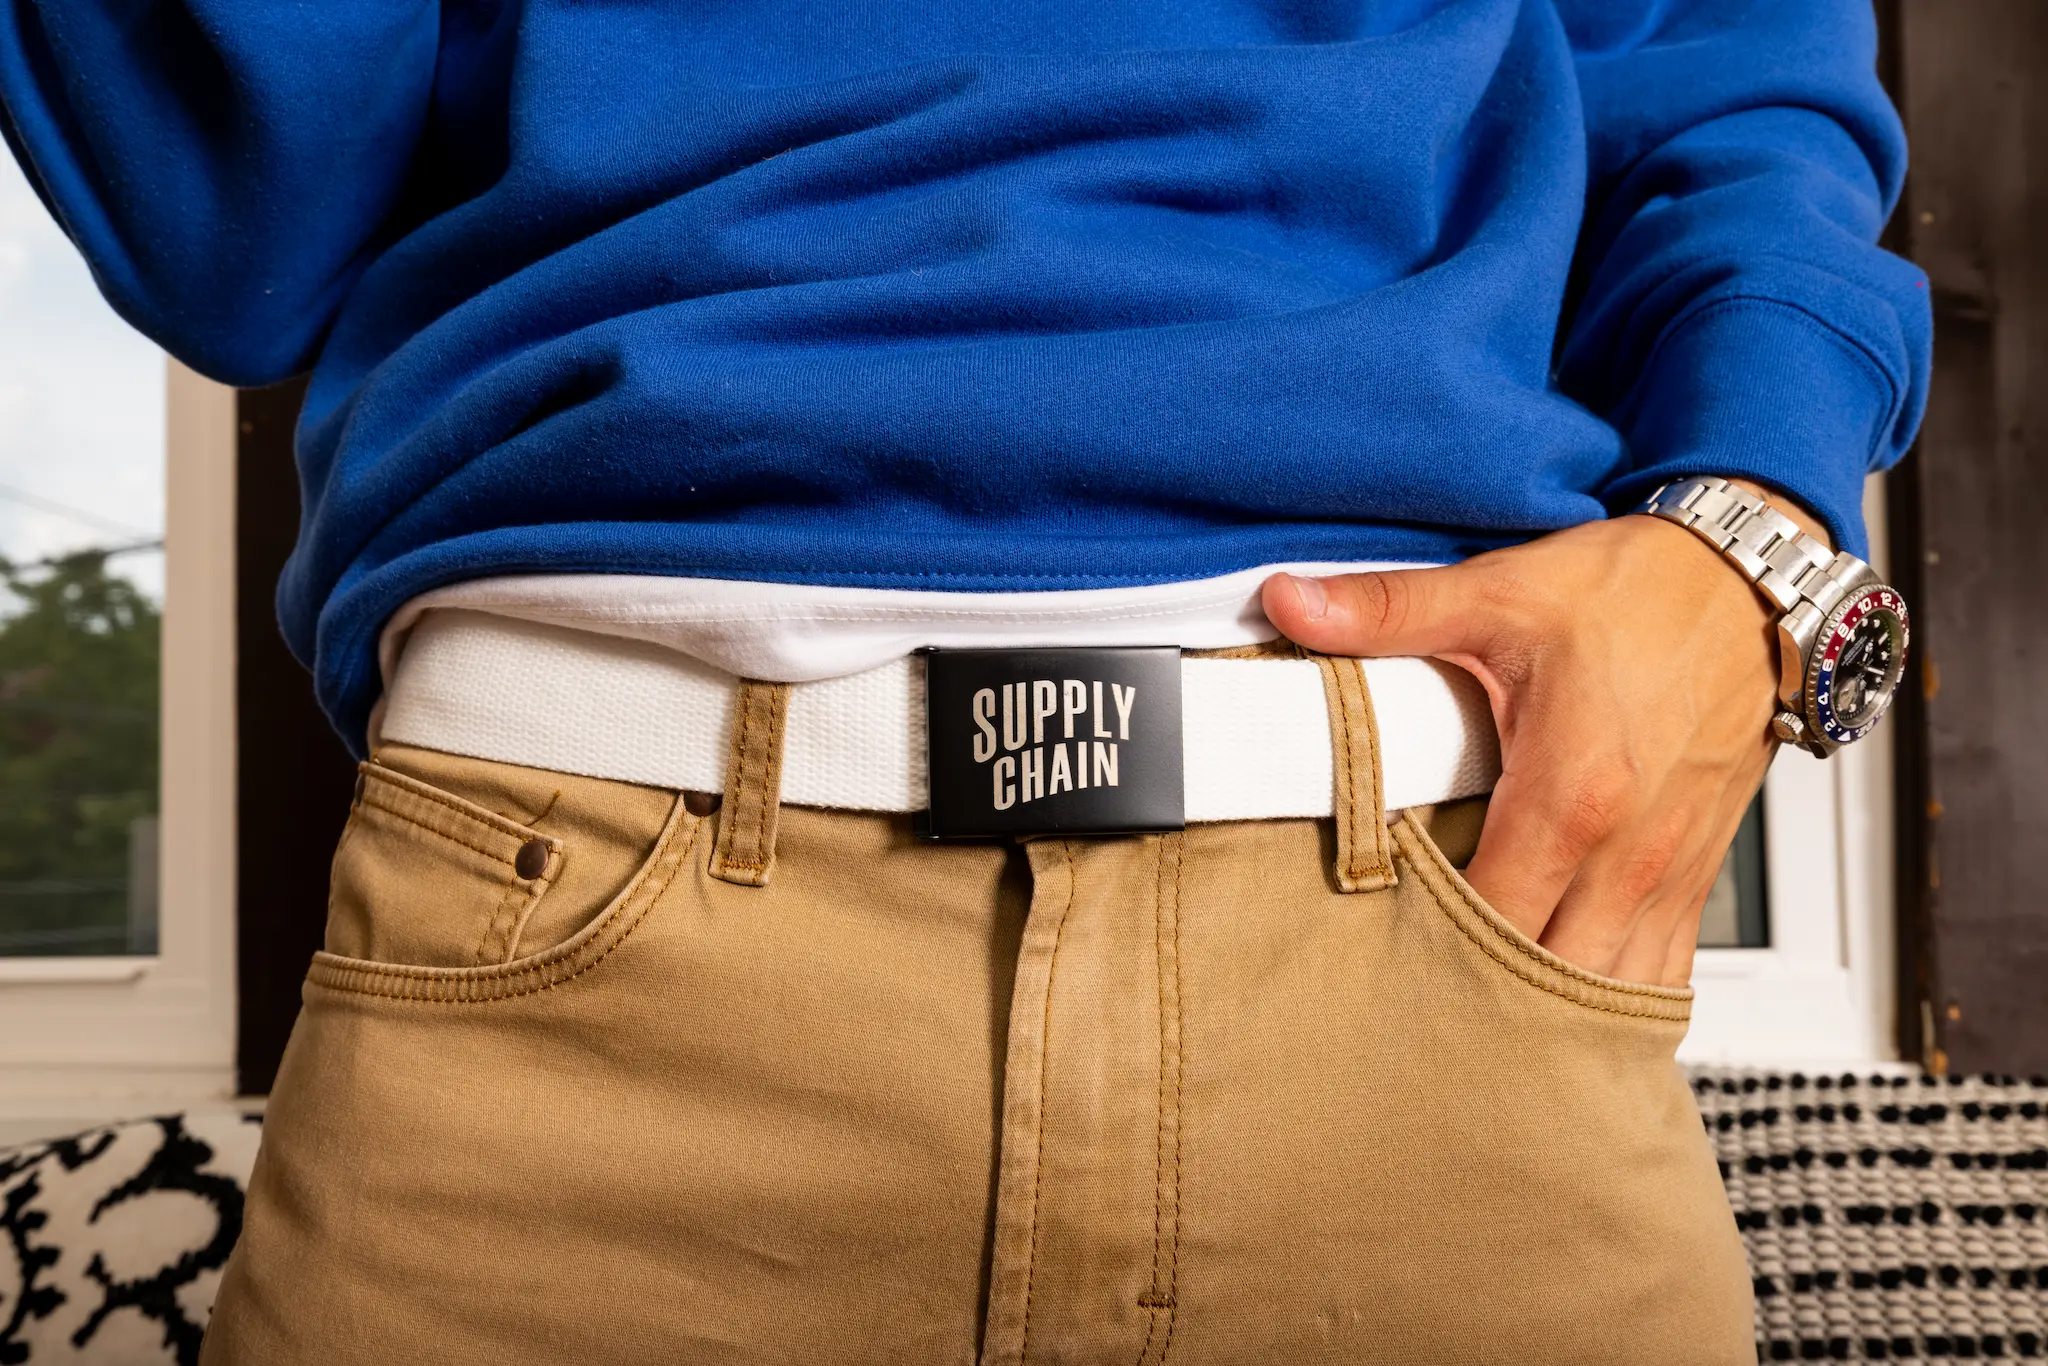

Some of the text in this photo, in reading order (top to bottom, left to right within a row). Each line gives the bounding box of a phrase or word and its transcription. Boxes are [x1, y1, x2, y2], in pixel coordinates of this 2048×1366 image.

[1857, 597, 1872, 614] 10
[1880, 592, 1892, 606] 12
[1837, 622, 1849, 638] 8
[1822, 658, 1834, 672] 6
[1817, 692, 1829, 705] 4
[972, 679, 1136, 763] SUPPLY
[1824, 718, 1837, 732] 2
[993, 741, 1119, 811] CHAIN
